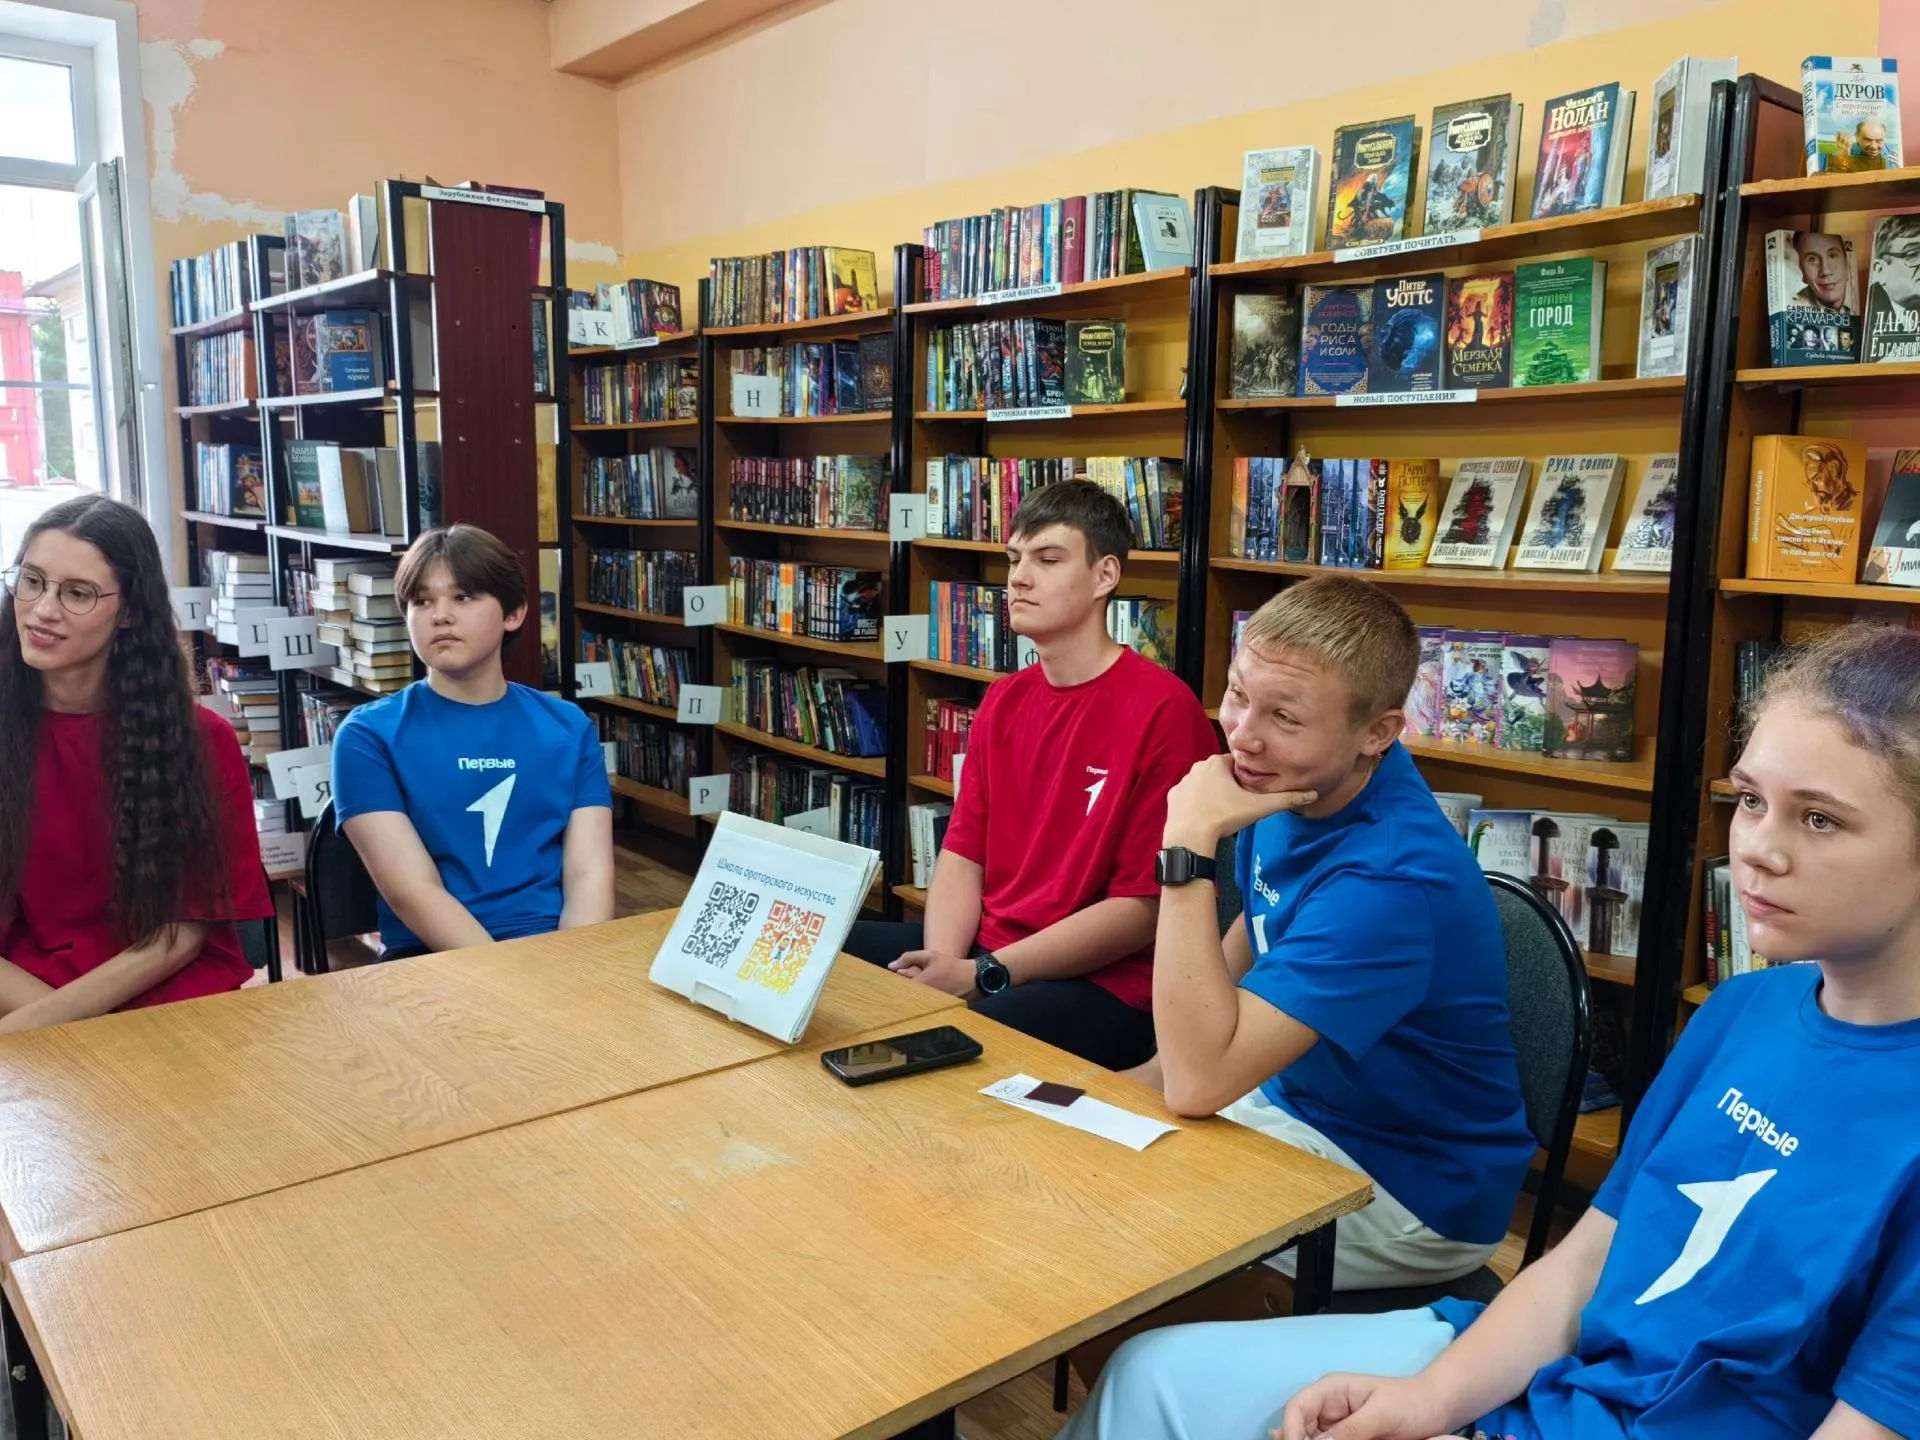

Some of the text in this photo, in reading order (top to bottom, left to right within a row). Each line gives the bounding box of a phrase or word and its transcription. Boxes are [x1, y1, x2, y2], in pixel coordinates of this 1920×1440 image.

[1834, 83, 1886, 99] ДУРОВ
[1548, 101, 1610, 133] НОЛАН
[438, 189, 484, 201] Зарубежная
[485, 195, 529, 207] Фантастика
[1353, 242, 1403, 259] СОВЕТУЕМ
[1404, 235, 1457, 250] ПОЧИТАТЬ
[1399, 280, 1426, 292] ПИТЕР
[1385, 288, 1434, 308] УОТТС
[1529, 304, 1574, 329] ГОРОД
[1786, 304, 1821, 312] САВЕЛИЙ
[1320, 323, 1357, 333] ГОДЫ
[1785, 312, 1851, 327] КРАМАРОВ
[594, 321, 608, 337] К
[1320, 335, 1356, 345] РИСА
[1319, 347, 1356, 357] И СОЛИ
[1452, 347, 1503, 364] МЕРЗКАЯ
[1452, 361, 1503, 377] СЕМЕРКА
[746, 389, 761, 408] Н
[1353, 392, 1457, 404] НОВЫЕ ПОСТУПЛЕНИЯ
[1403, 463, 1427, 475] ГАРРИ
[1545, 458, 1576, 473] РУНА
[1398, 475, 1431, 488] ПОТТЕР
[900, 508, 913, 529] Т
[184, 602, 200, 620] Т
[690, 594, 705, 613] О
[284, 633, 315, 657] Ш
[1025, 648, 1041, 666] Ф
[687, 697, 702, 714] П
[457, 757, 516, 773] Первые
[315, 780, 333, 804] Я
[717, 857, 744, 876] Школа
[743, 867, 794, 892] ораторского
[1716, 1087, 1799, 1157] Первые
